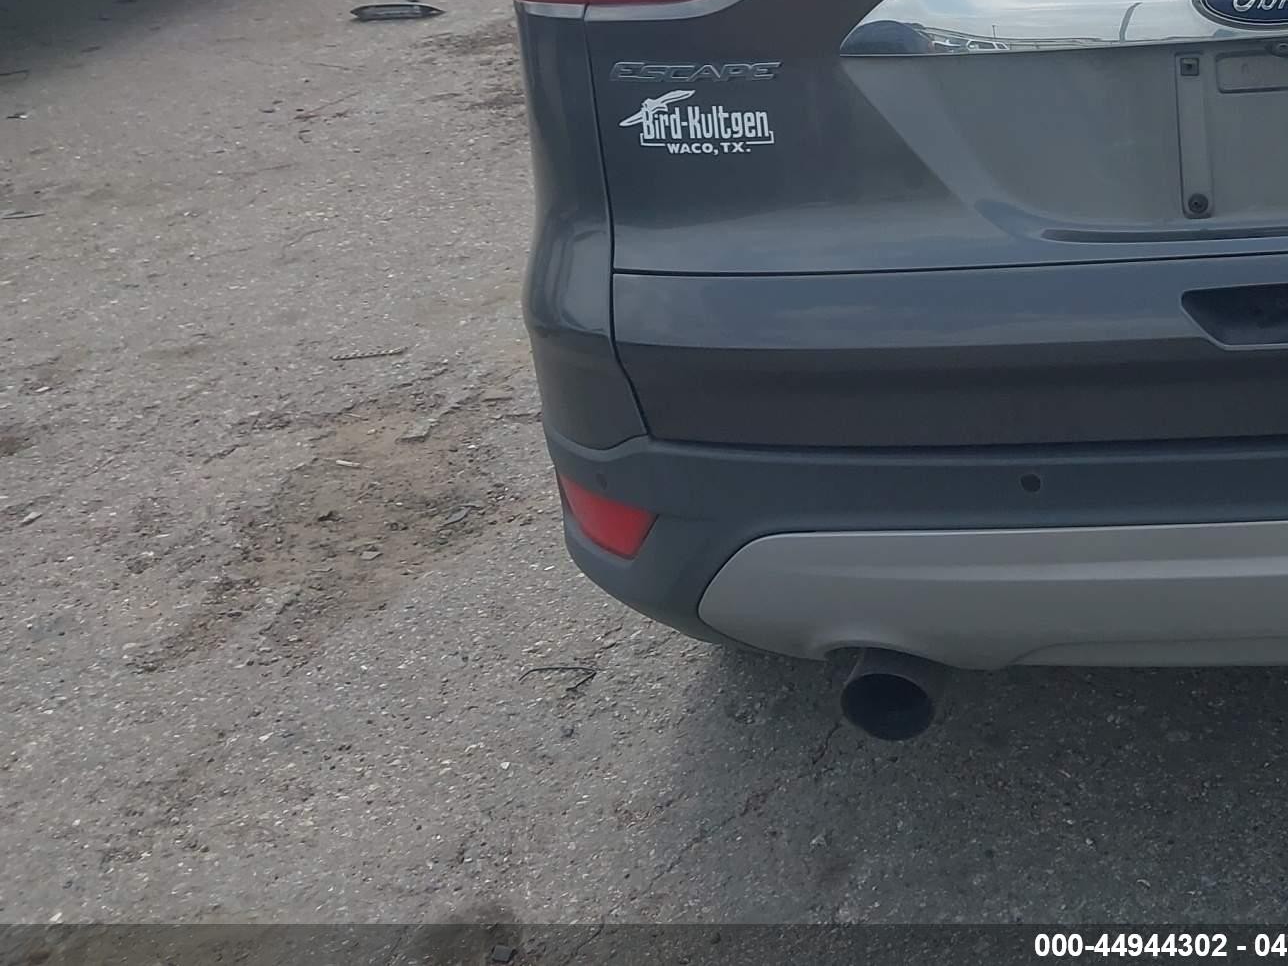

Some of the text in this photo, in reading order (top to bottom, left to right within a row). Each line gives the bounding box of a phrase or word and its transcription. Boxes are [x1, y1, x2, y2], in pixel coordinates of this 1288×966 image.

[610, 61, 781, 82] ESCAPE
[642, 105, 770, 140] Bird-Kultgen
[667, 141, 751, 155] WACO, TX.
